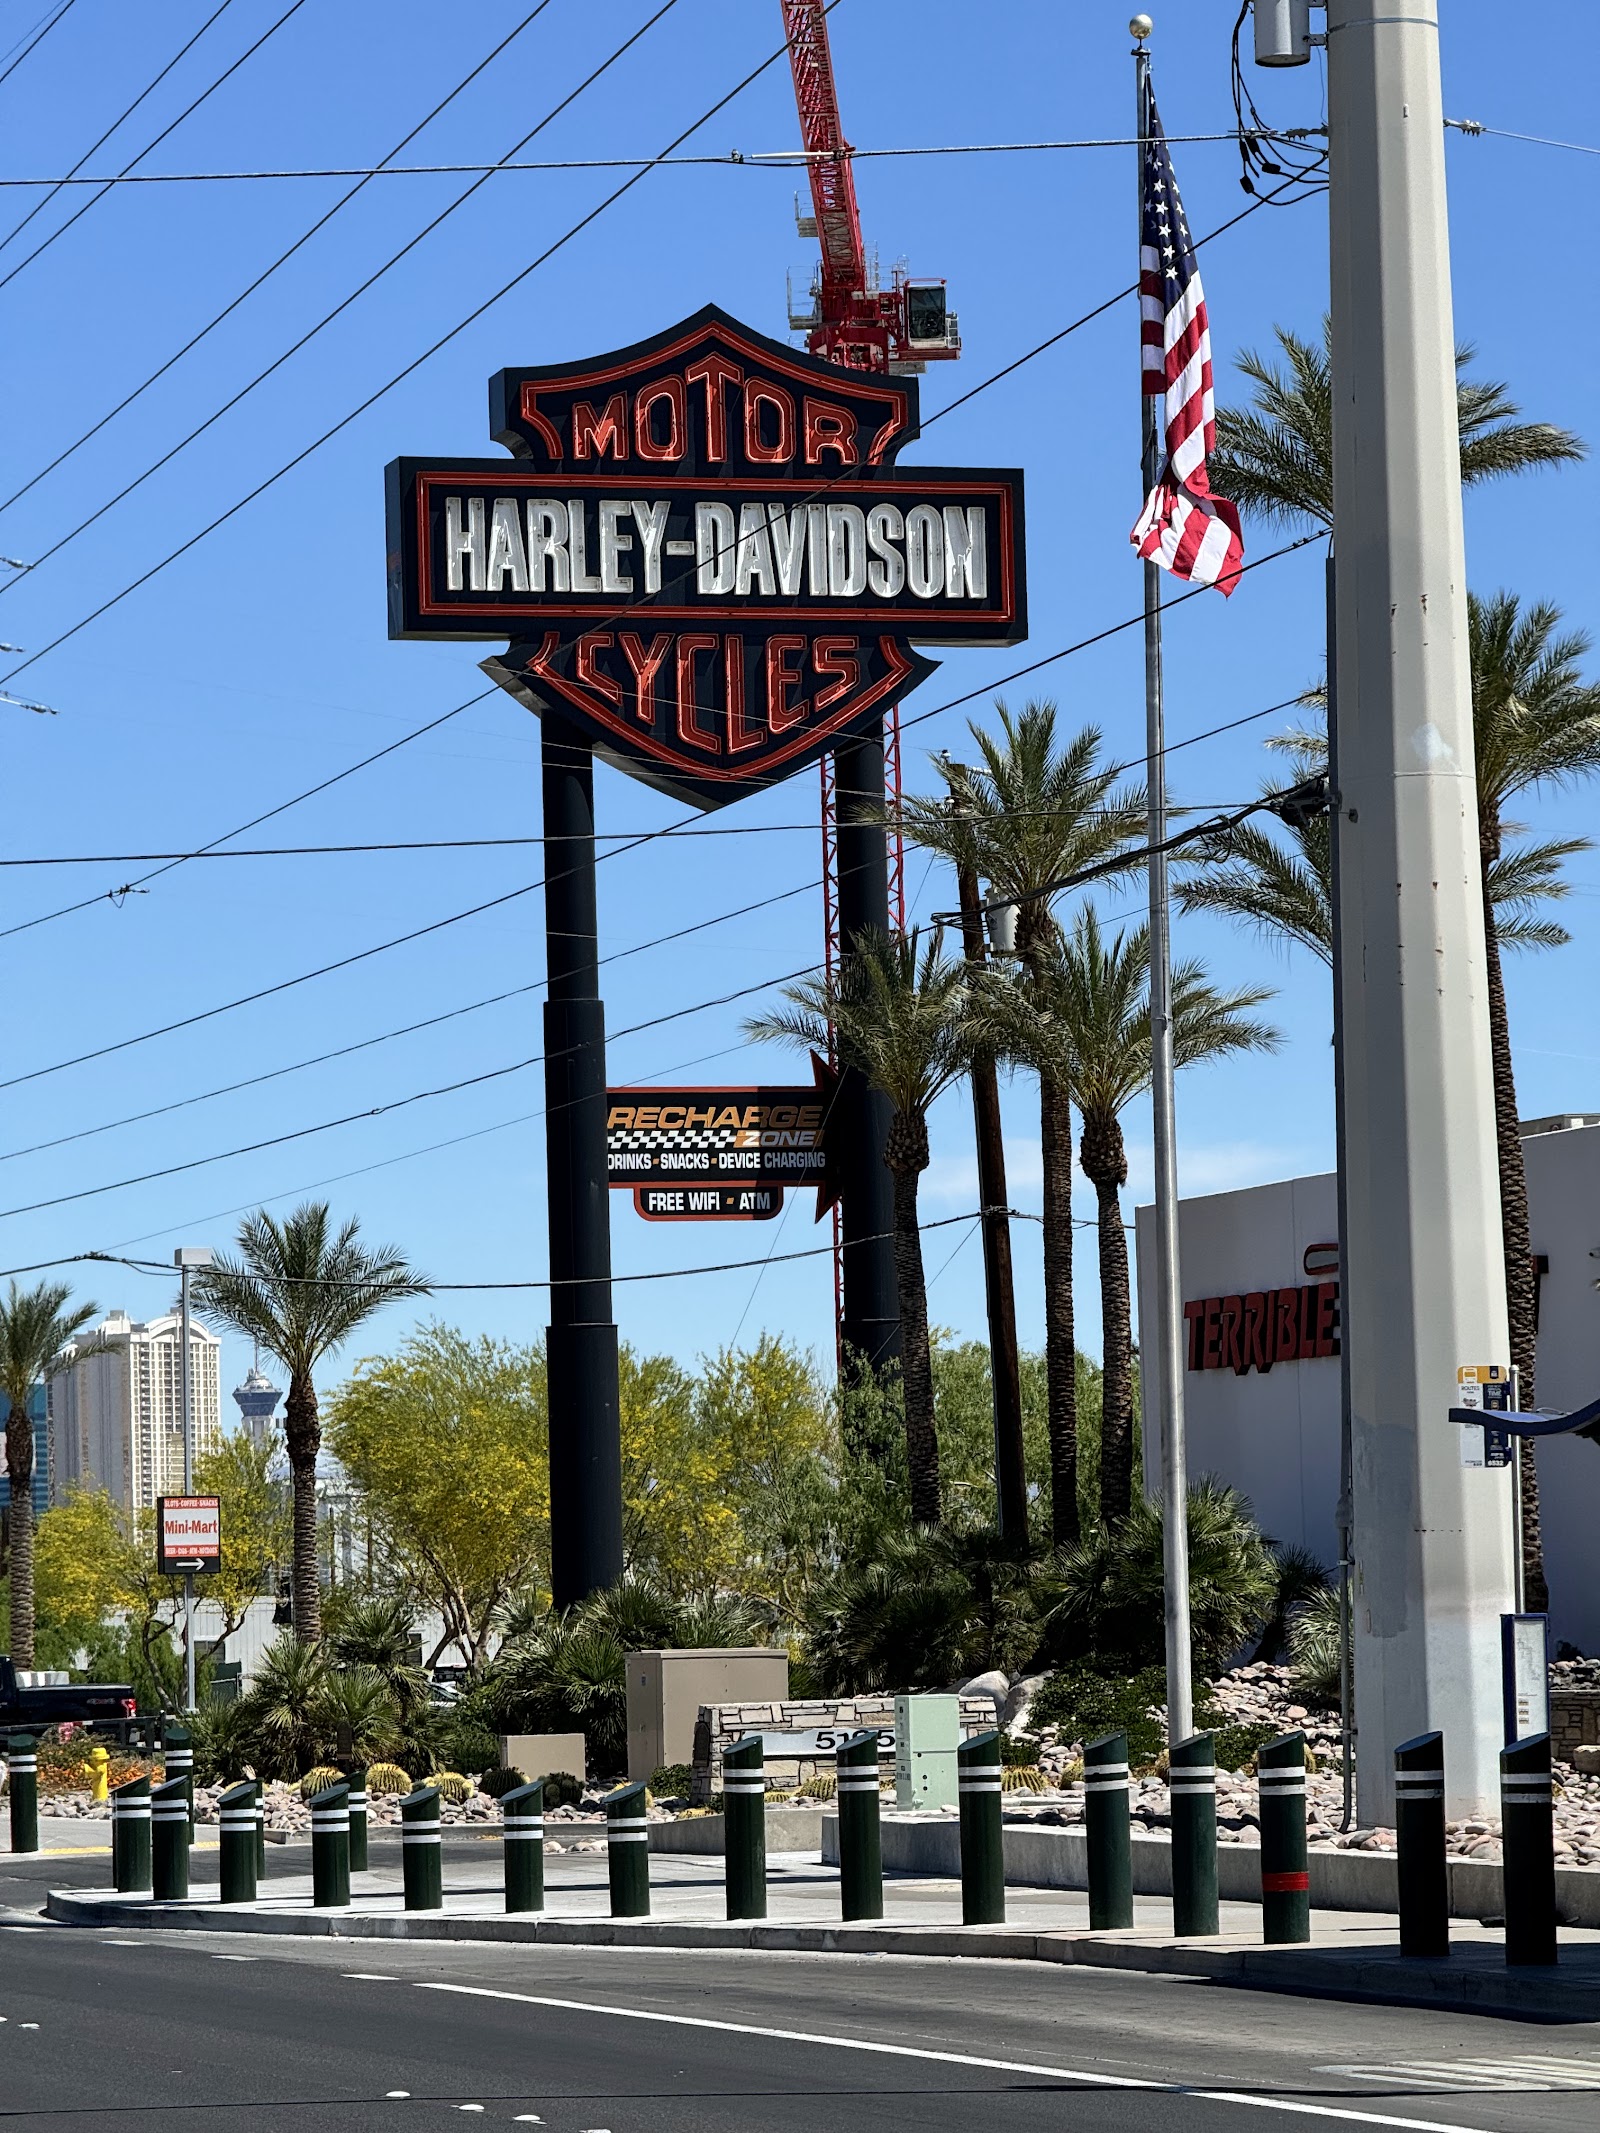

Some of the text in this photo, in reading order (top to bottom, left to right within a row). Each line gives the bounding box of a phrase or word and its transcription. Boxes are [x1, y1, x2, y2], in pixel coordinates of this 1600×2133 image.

[572, 351, 859, 465] MOTOR
[445, 497, 988, 599] HARLEY-DAVIDSON
[575, 631, 860, 755] CYCLES
[607, 1106, 823, 1129] RECHARGE
[742, 1131, 816, 1146] ZONE
[608, 1152, 826, 1170] DRINKS SNACKS DEVICE CHARGING
[648, 1192, 771, 1211] FREE WIFI ATM
[1184, 1282, 1341, 1376] TERRIBLE
[165, 1520, 218, 1534] Mini-Mart
